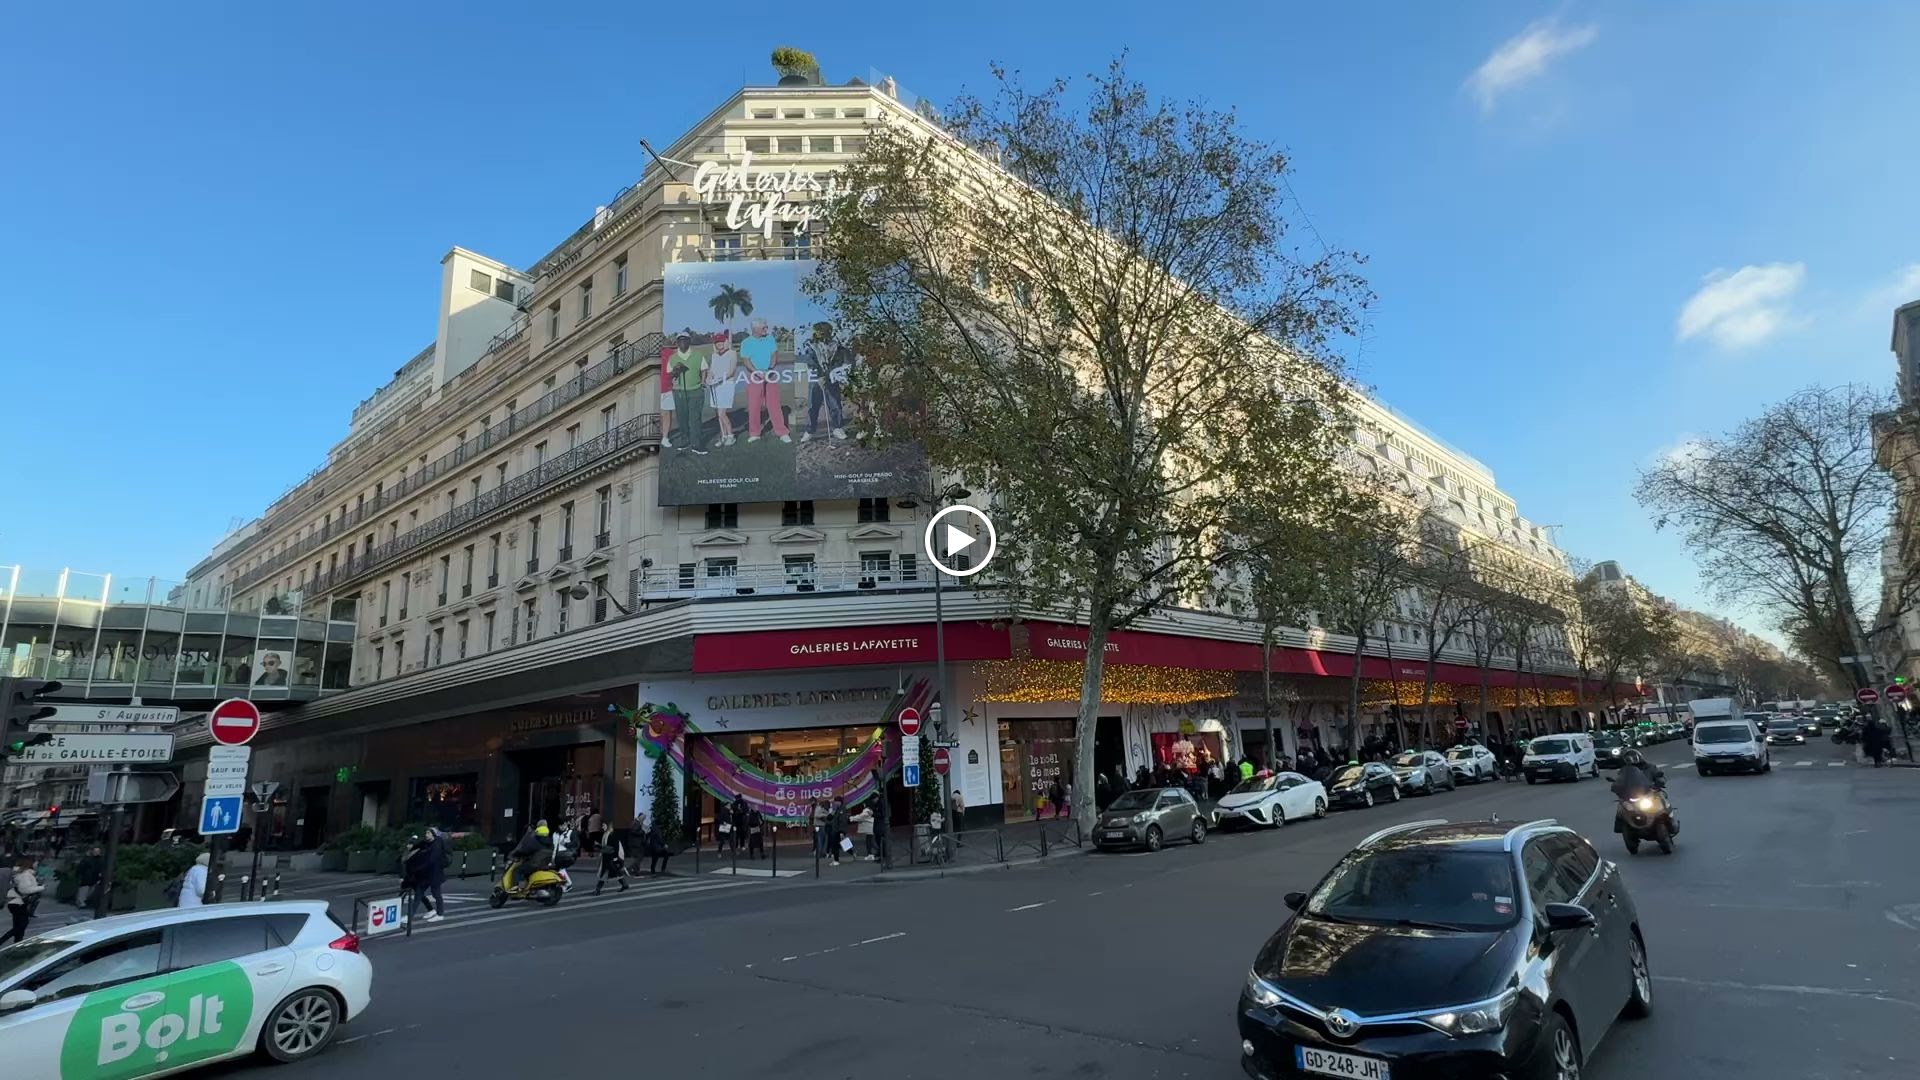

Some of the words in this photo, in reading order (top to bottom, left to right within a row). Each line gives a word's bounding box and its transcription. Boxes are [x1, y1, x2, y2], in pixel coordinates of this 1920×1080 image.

[694, 151, 821, 204] Galeries
[722, 368, 819, 385] LACOSTE
[789, 641, 849, 655] GALERIES
[852, 638, 919, 651] LAFAYETTE
[1046, 638, 1082, 650] GALERIES
[707, 692, 792, 711] GALERIES
[796, 686, 892, 706] LAFAYETTE
[116, 710, 174, 722] Augustin
[774, 787, 796, 800] de
[799, 786, 833, 799] mes
[97, 992, 225, 1066] Bolt
[1305, 1051, 1378, 1078] GD-248-JH
